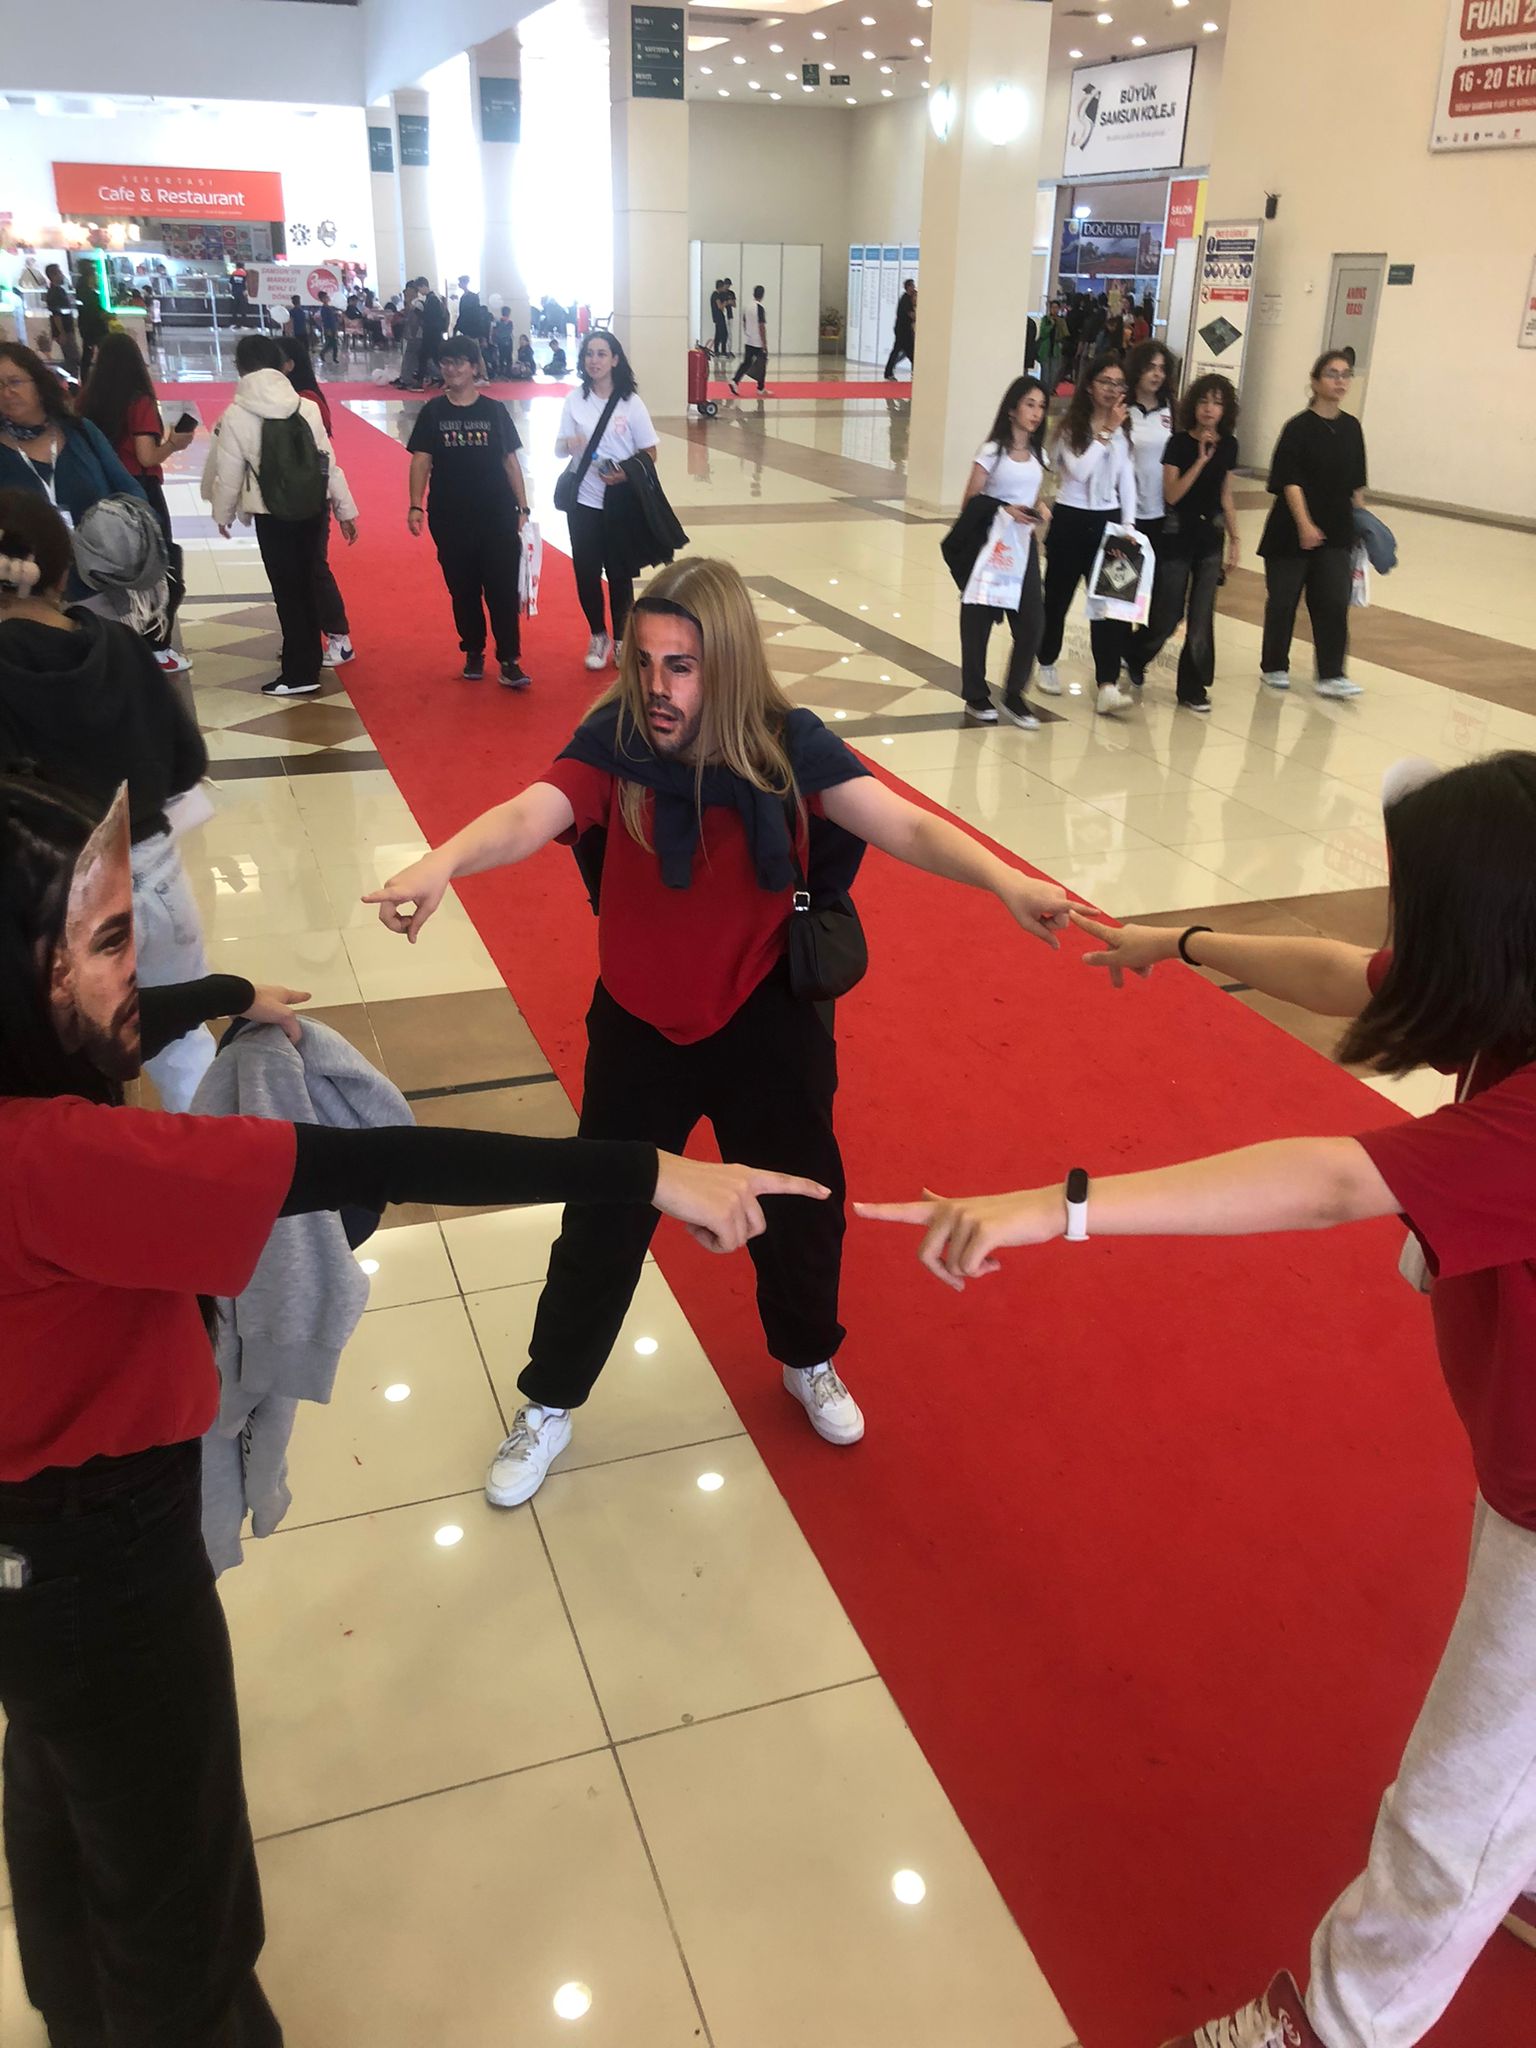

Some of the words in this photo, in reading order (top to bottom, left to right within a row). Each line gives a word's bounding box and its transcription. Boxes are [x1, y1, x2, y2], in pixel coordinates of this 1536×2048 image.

[1466, 0, 1518, 30] FUARI
[1459, 70, 1475, 92] 16
[1483, 67, 1503, 90] 20
[1120, 82, 1158, 104] BÜYÜK
[1100, 107, 1140, 126] SAMSUN
[98, 186, 136, 203] Cafe
[140, 187, 153, 203] &
[157, 187, 246, 207] Restaurant
[1171, 204, 1193, 216] SALON
[1083, 221, 1139, 237] DOĞUBATI
